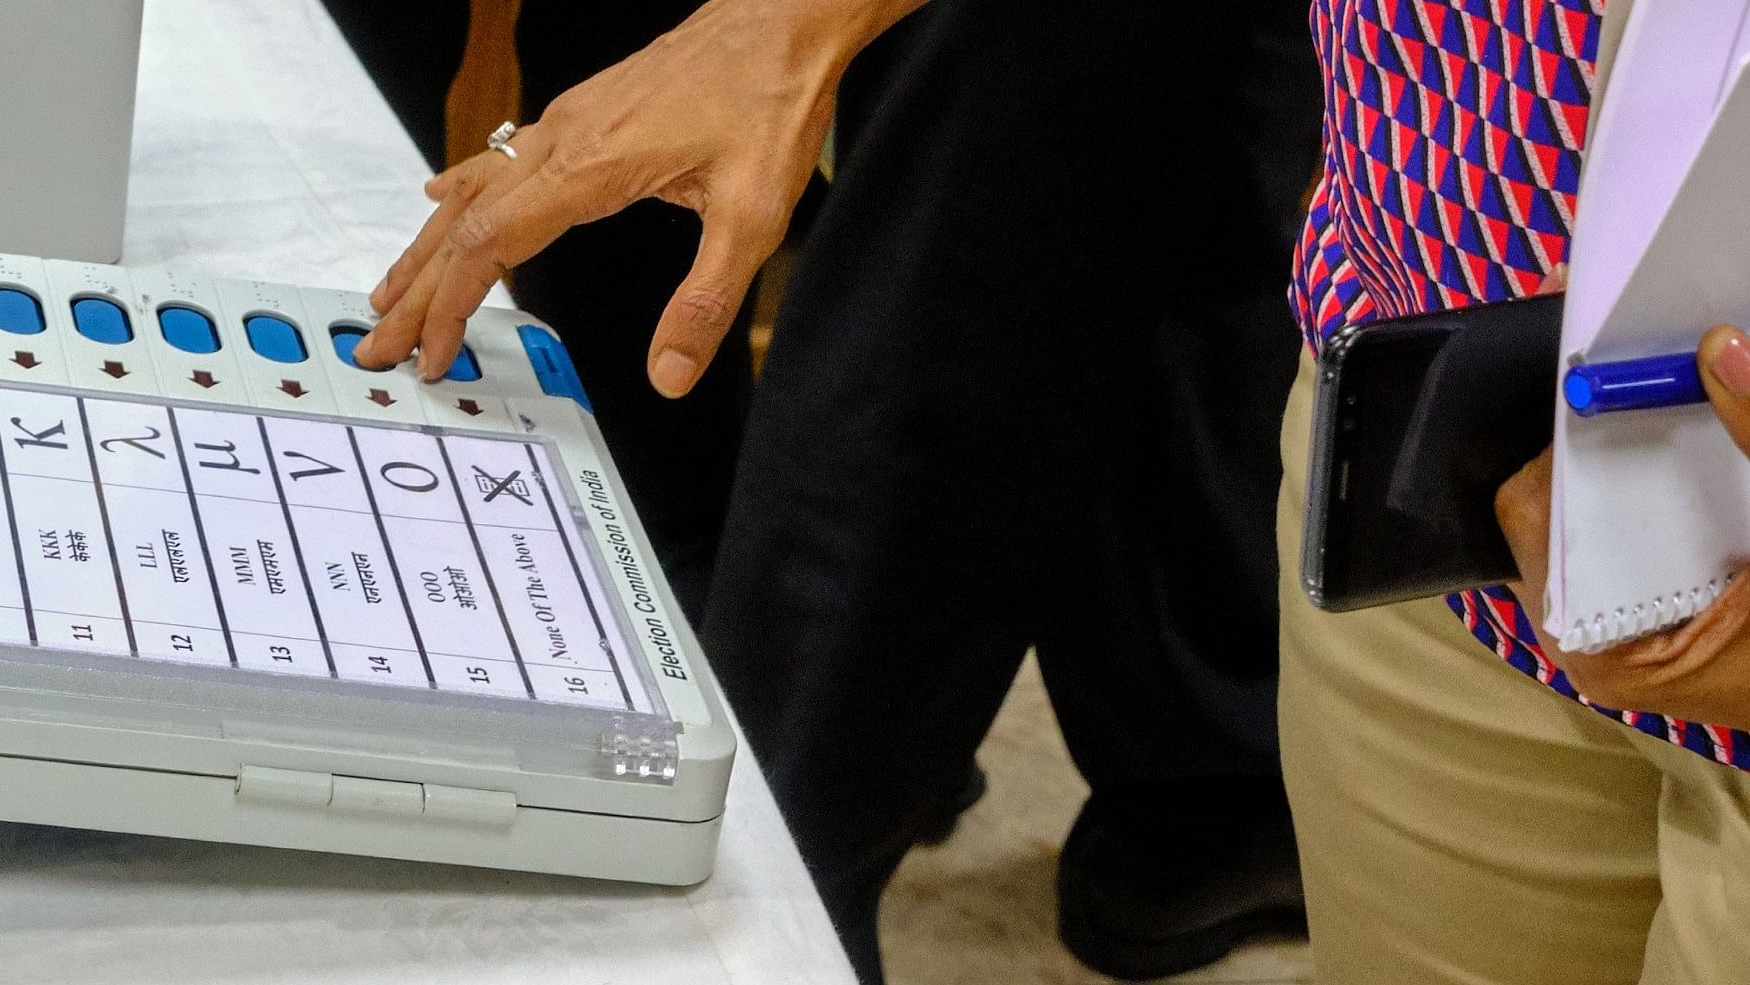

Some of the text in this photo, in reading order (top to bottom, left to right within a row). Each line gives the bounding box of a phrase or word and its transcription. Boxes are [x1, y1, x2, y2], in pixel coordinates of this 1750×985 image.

[39, 529, 61, 560] KKK
[136, 543, 157, 568] LLL
[229, 547, 256, 585] MMM
[325, 562, 351, 591] NNN
[580, 469, 688, 681] Election Commission of India
[420, 572, 446, 602] OOO
[512, 533, 570, 661] None Of The Above
[71, 625, 93, 641] 11
[170, 635, 193, 652] 12
[269, 646, 293, 663] 13
[368, 656, 392, 673] 14
[466, 667, 490, 684] 15
[564, 677, 588, 694] 16
